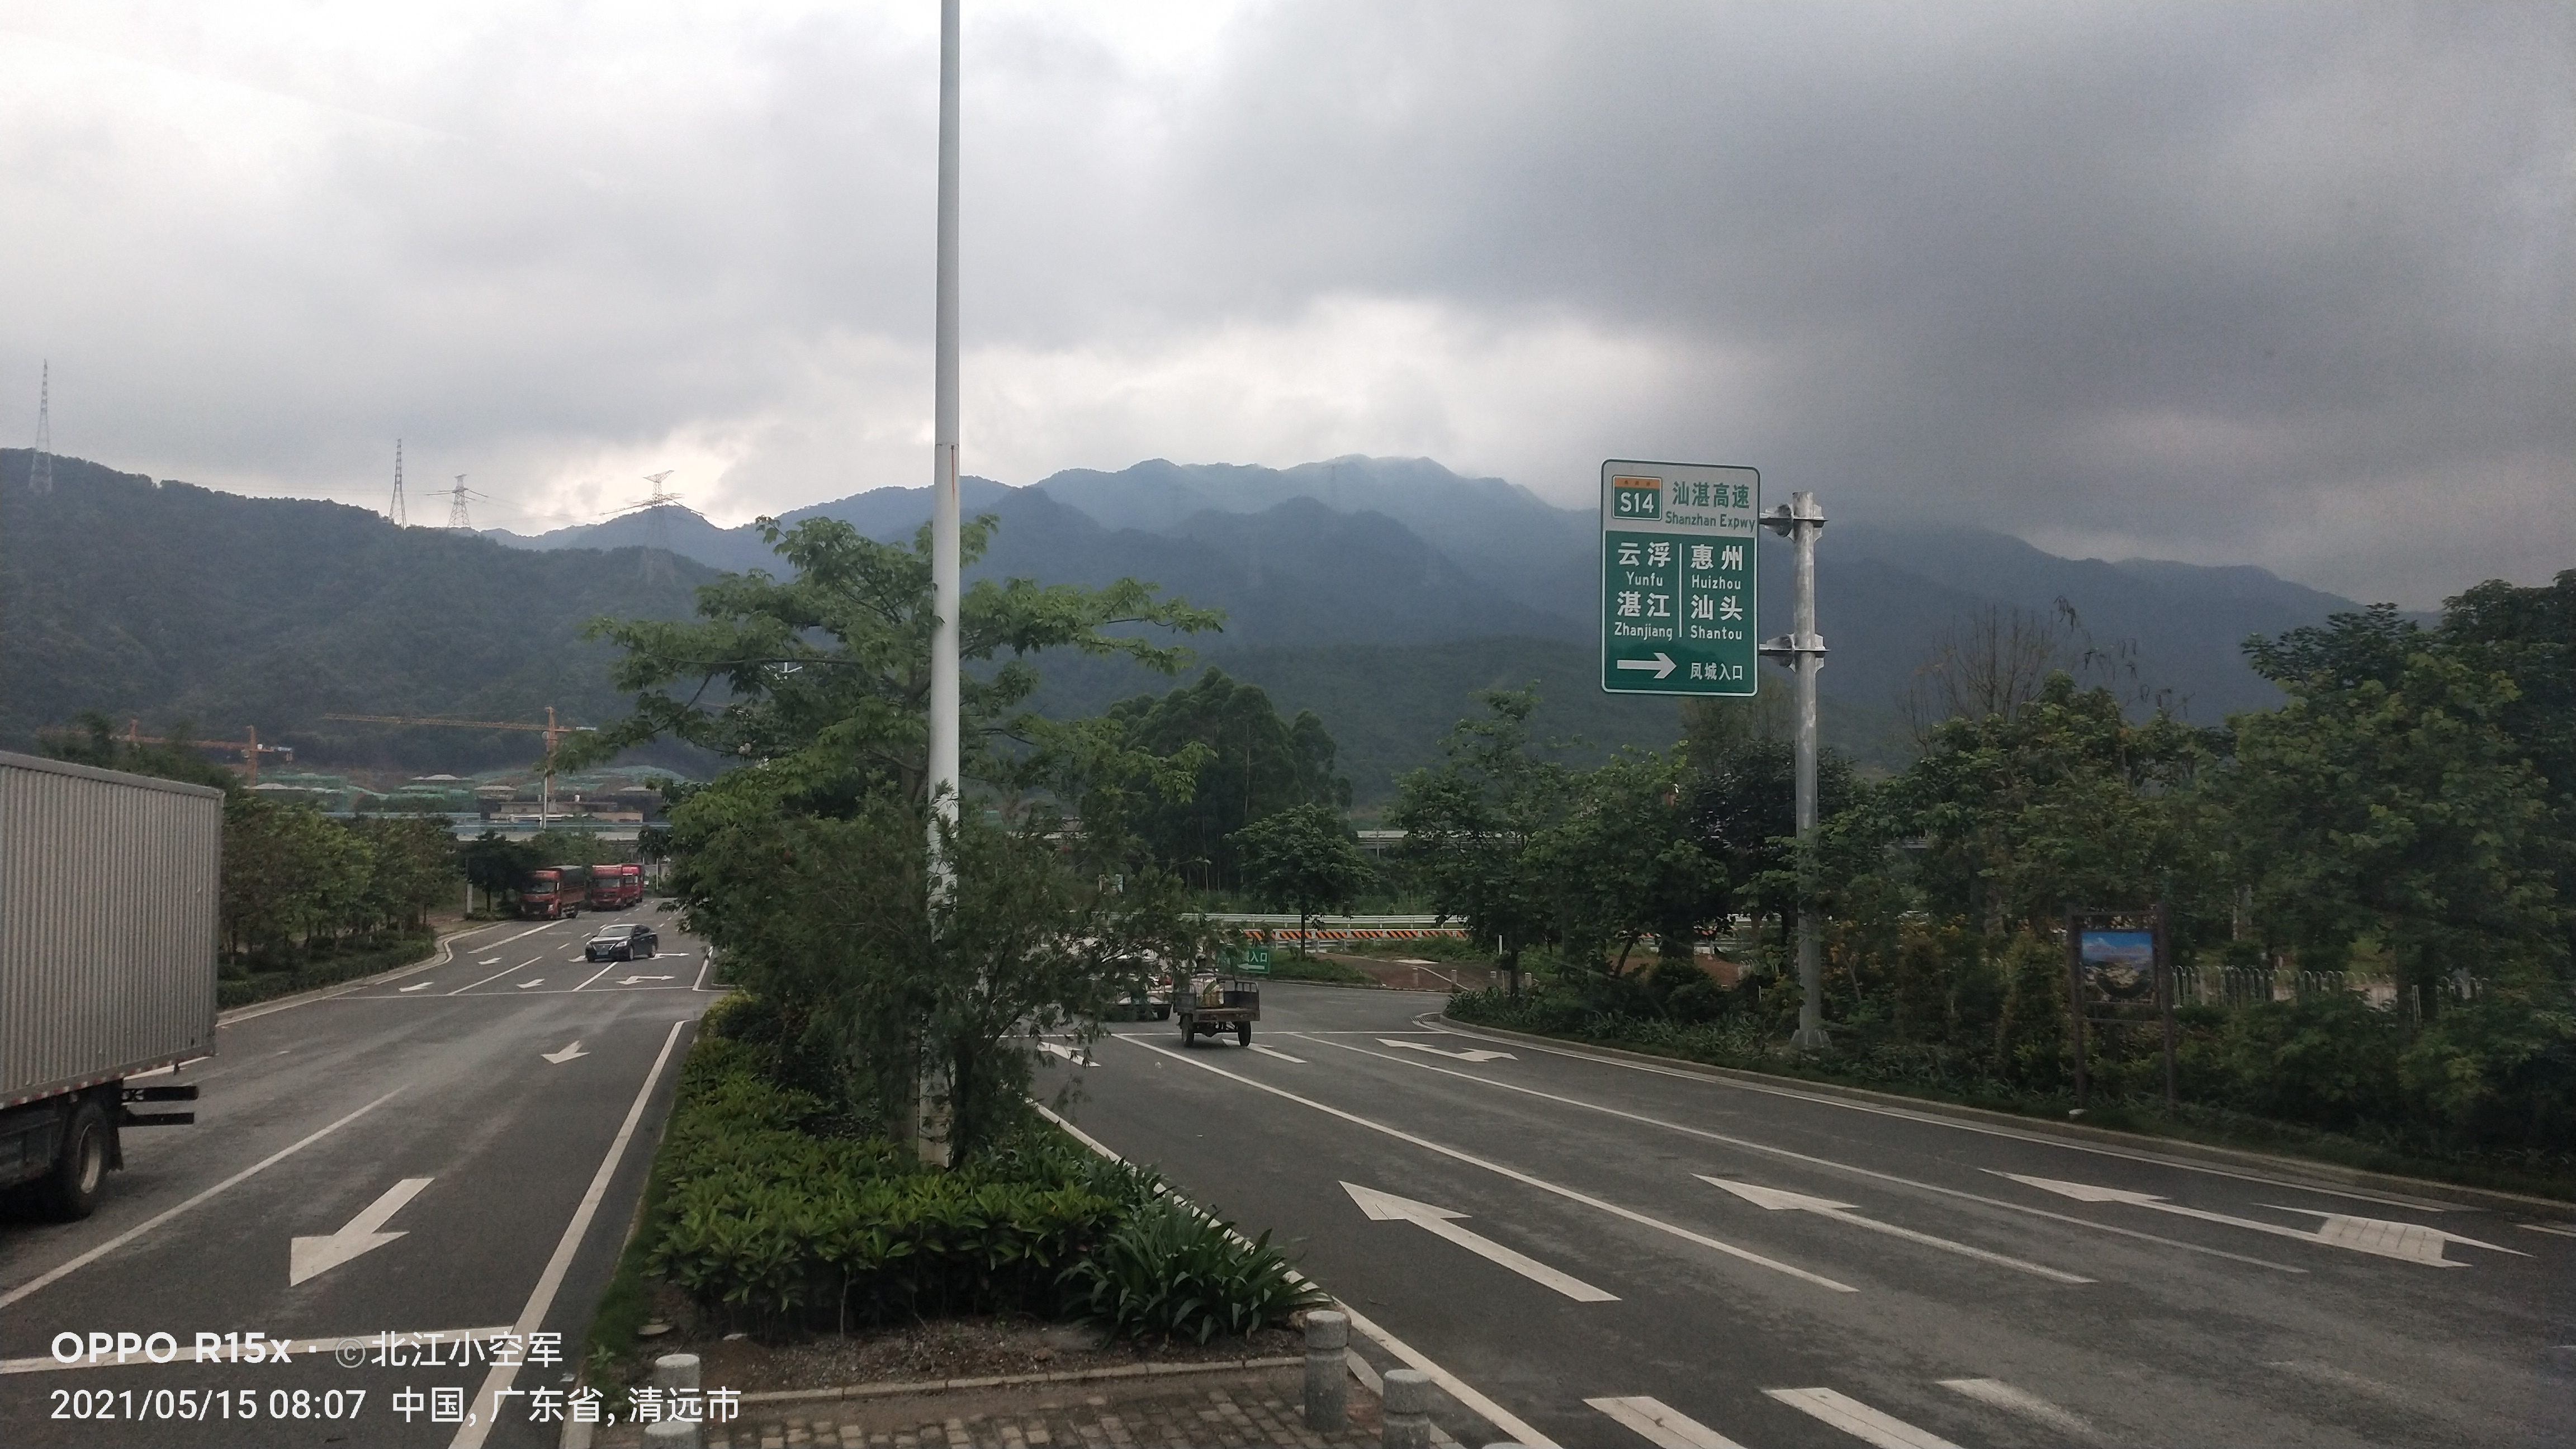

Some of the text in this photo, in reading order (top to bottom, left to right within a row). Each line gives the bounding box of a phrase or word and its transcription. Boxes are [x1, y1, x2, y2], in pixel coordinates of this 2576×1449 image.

[1620, 491, 1654, 513] S14
[1672, 481, 1750, 509] 汕湛高速
[1665, 511, 1755, 533] Shanzhan Expwy
[1617, 541, 1671, 568] 云浮
[1690, 543, 1743, 571] 惠州
[1626, 571, 1664, 586] Yunfu
[1691, 574, 1741, 590] Huizhou
[1617, 590, 1671, 618] 湛江
[1690, 594, 1743, 621] 汕头
[1614, 622, 1673, 641] Zhanjiang
[1690, 624, 1742, 641] Shantou
[1689, 662, 1743, 681] 凤城入口
[1244, 951, 1268, 963] 入口
